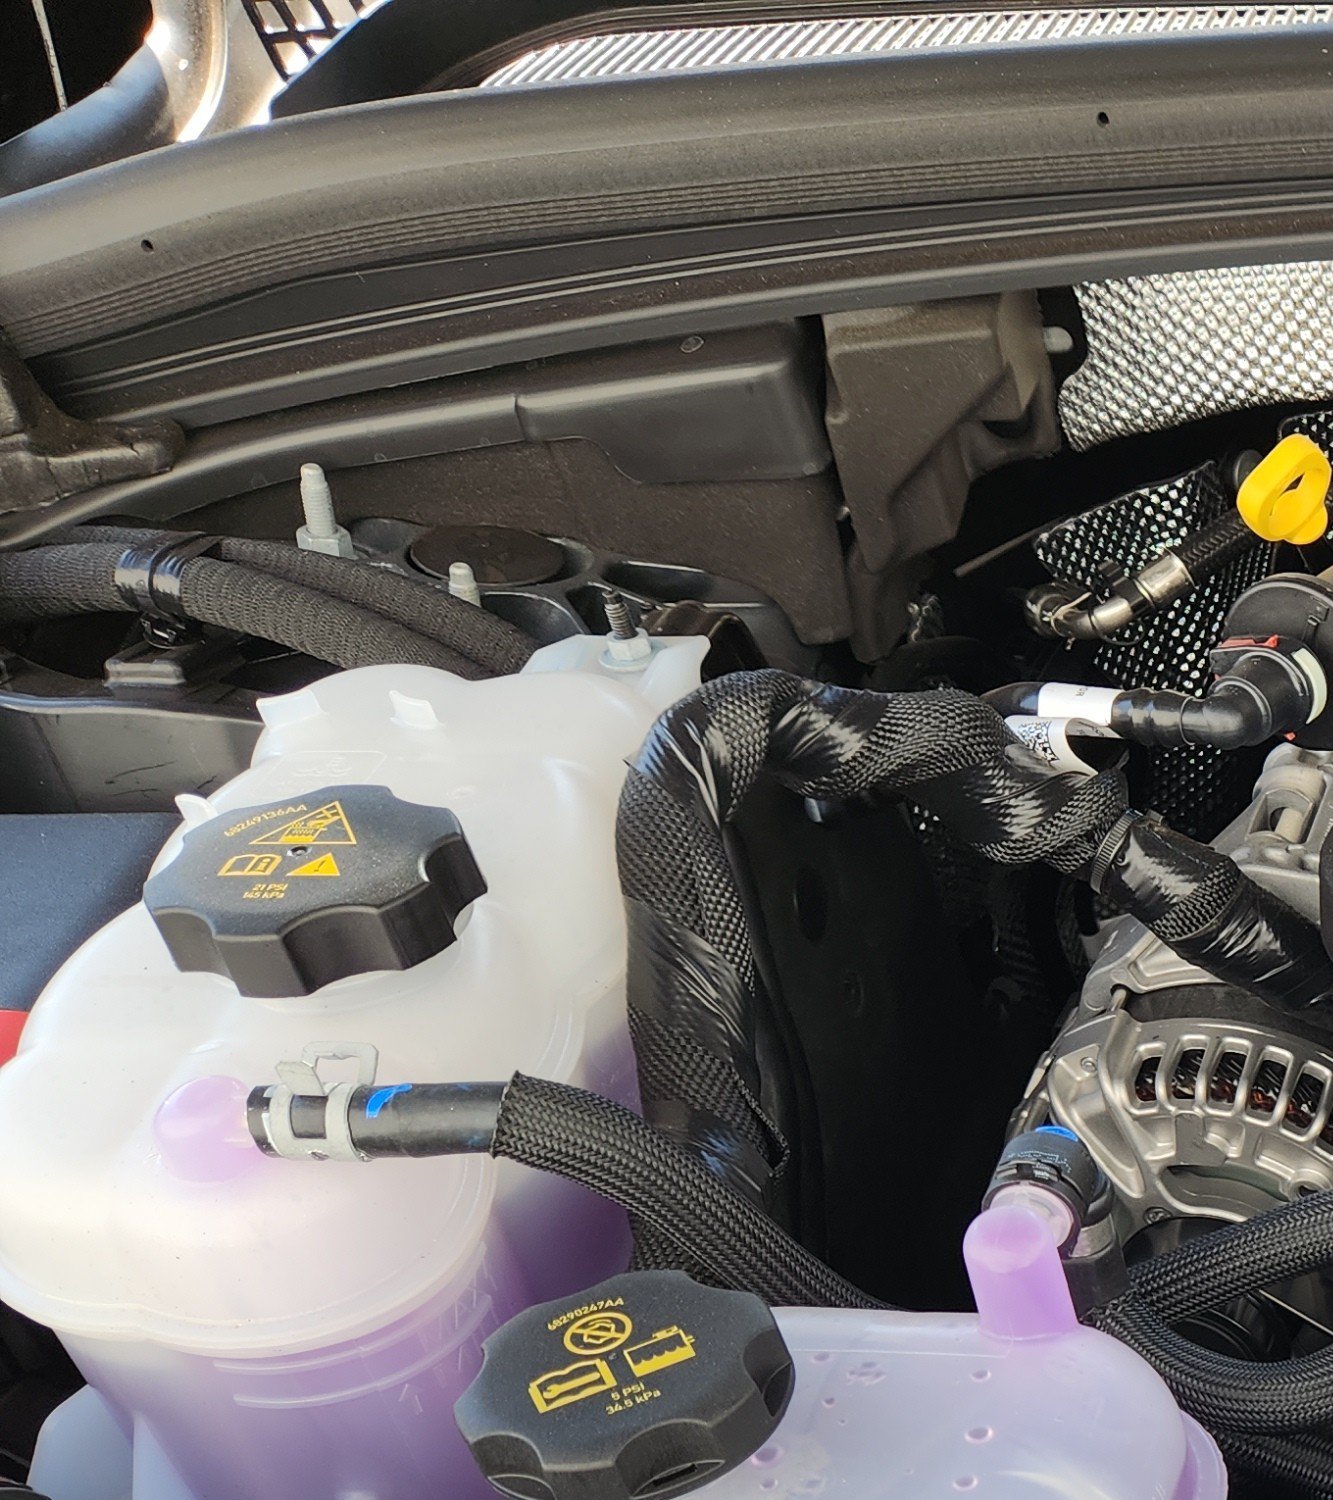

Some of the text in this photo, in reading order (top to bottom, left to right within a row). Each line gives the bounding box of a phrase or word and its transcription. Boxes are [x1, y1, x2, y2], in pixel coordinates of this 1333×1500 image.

[622, 1382, 645, 1396] PSI
[605, 1389, 661, 1415] 34.5 kPa
